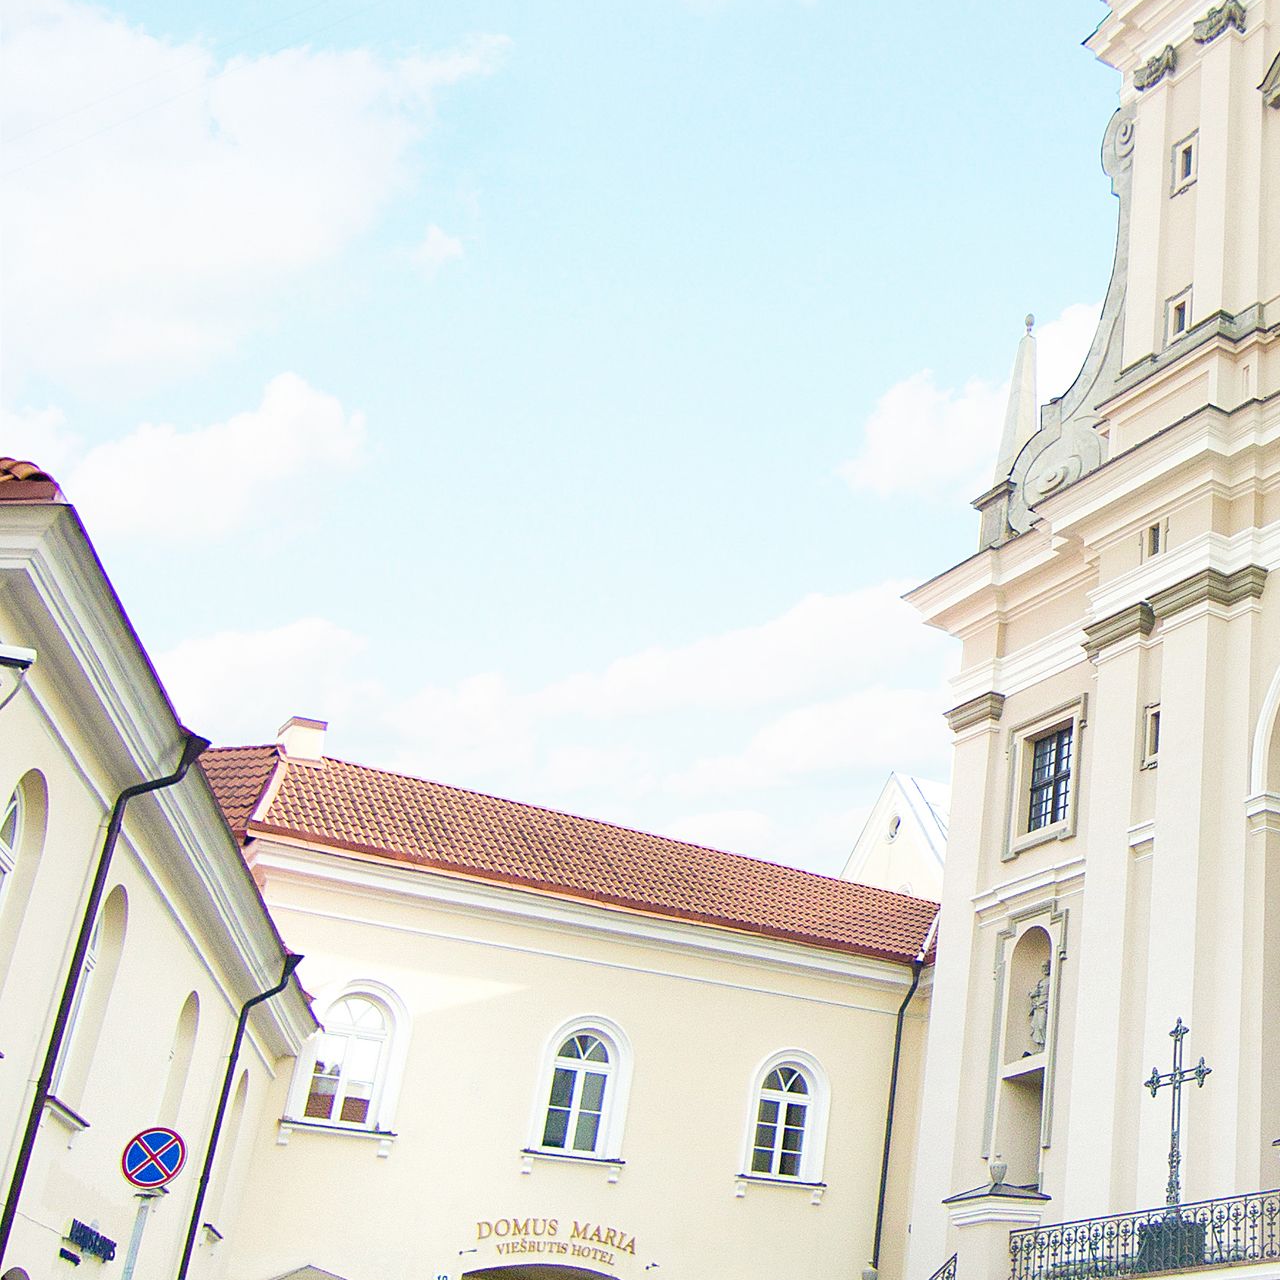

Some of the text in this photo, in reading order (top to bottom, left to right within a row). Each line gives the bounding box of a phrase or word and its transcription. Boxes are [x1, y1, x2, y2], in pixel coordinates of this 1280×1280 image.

[476, 1218, 637, 1255] DOMUS MARIA
[496, 1238, 615, 1266] VIEŠBUTIS HOTEL
